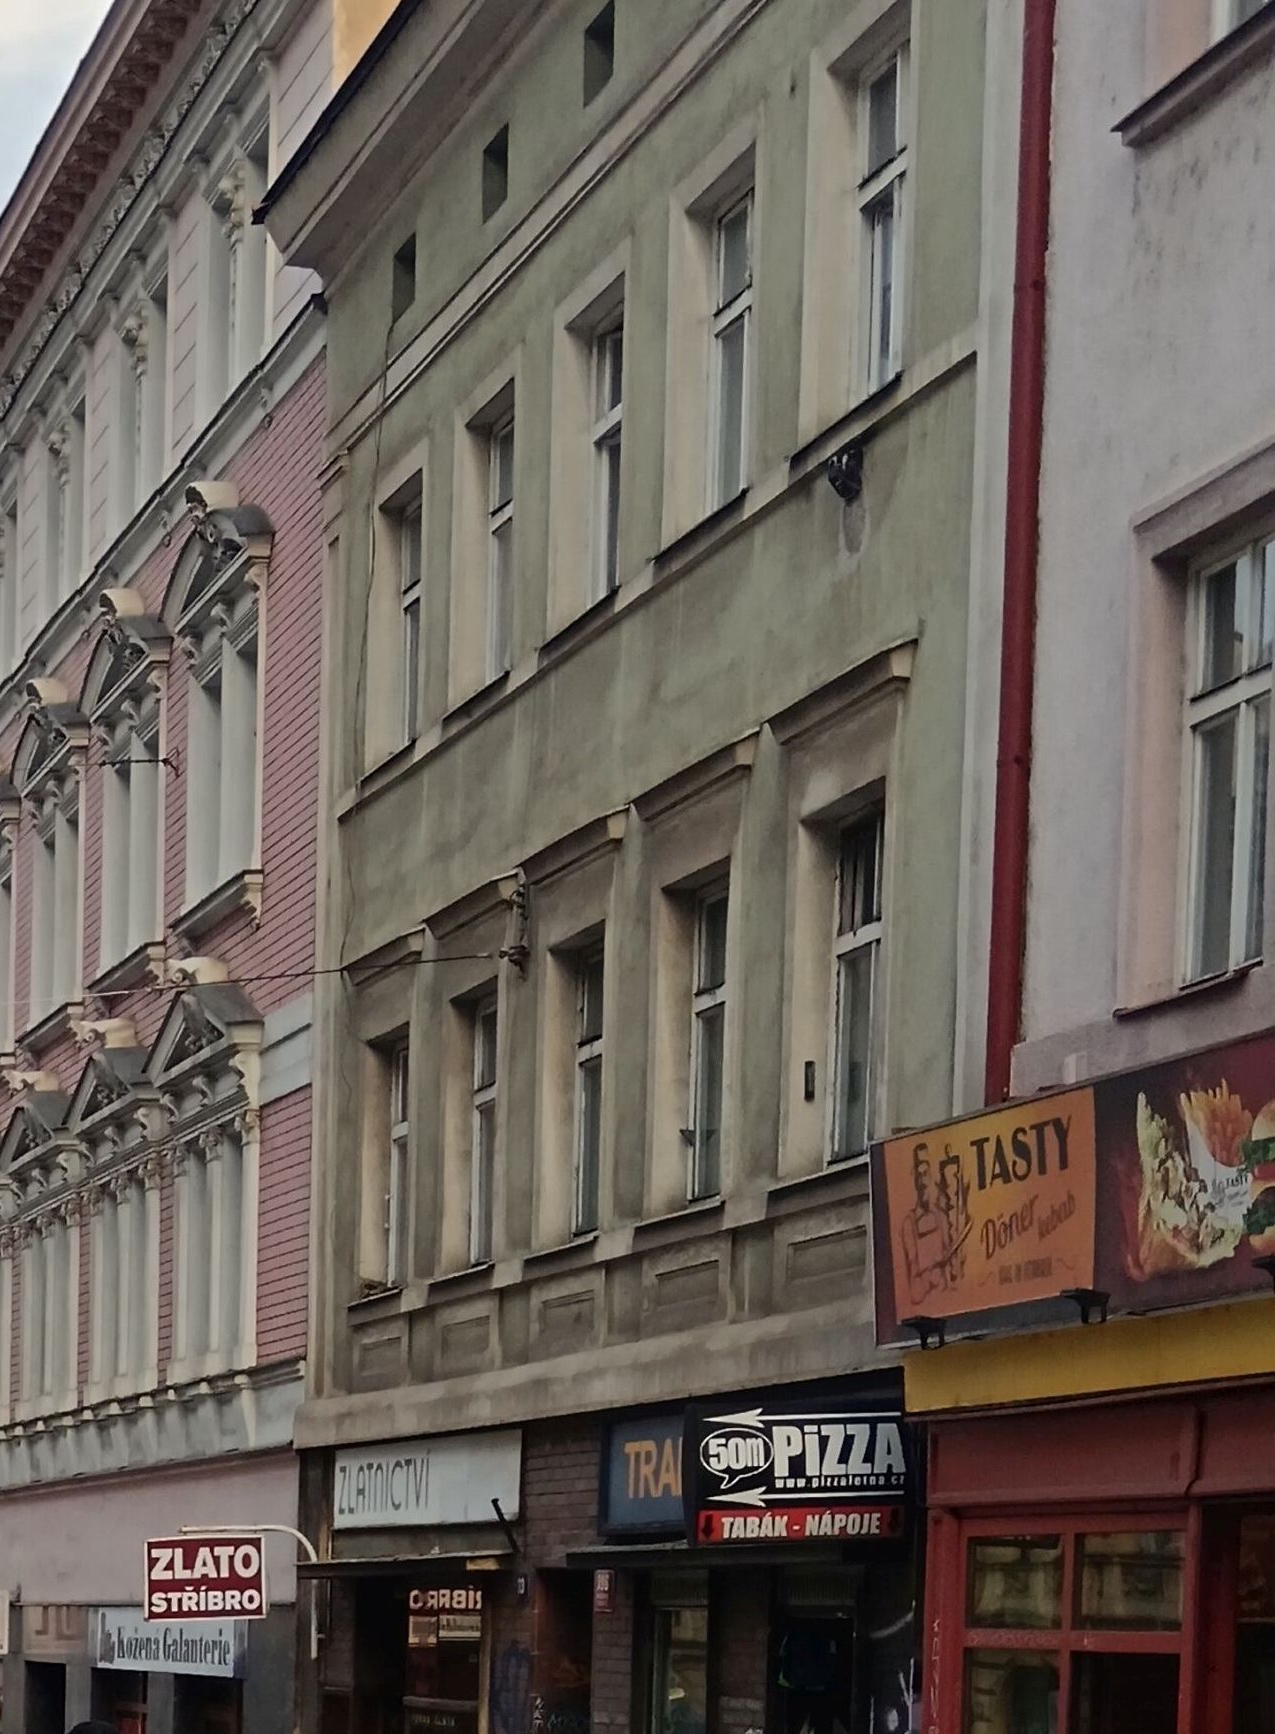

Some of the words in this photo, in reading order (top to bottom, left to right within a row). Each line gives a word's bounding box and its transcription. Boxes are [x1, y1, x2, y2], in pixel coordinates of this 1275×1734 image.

[970, 1115, 1072, 1191] TASTY
[980, 1193, 1039, 1260] Döner
[624, 1436, 683, 1499] TRA
[708, 1437, 764, 1471] 50m
[338, 1448, 431, 1515] ZLATNICTVÍ
[721, 1511, 789, 1539] TABÁK
[804, 1510, 881, 1537] NÁPOJE
[150, 1544, 260, 1581] ZLATO
[150, 1586, 261, 1614] STŘÍBRO
[117, 1626, 161, 1660] Kožená
[163, 1626, 231, 1667] Galanterie
